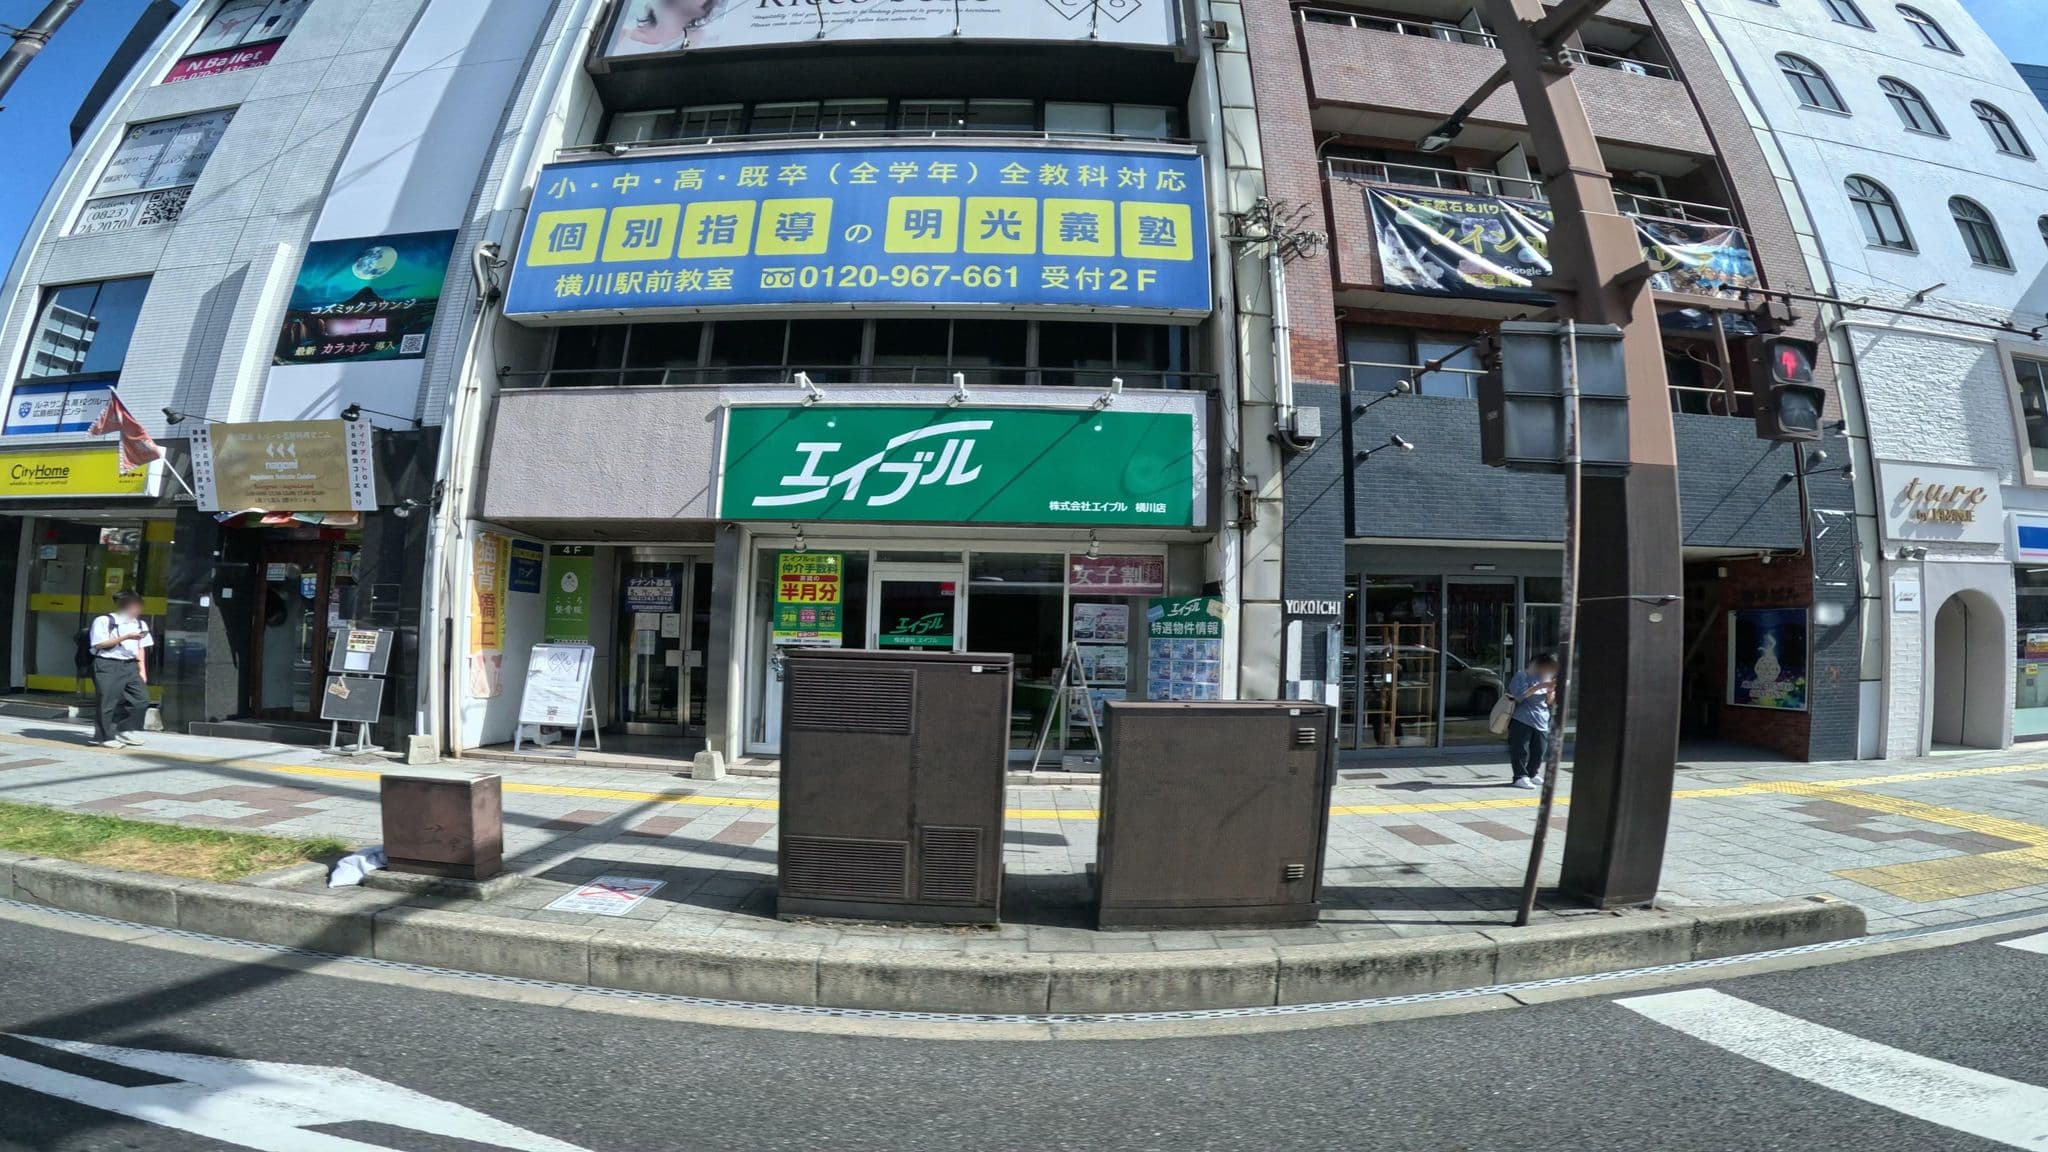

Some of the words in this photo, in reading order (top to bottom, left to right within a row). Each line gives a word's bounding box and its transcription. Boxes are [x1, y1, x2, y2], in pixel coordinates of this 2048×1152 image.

[548, 208, 1177, 253] 個別指導の明光義塾
[555, 267, 734, 298] 横川駅前教室
[799, 265, 1018, 289] 0120-967-661
[311, 298, 417, 315] コズミックラウンジ
[321, 342, 370, 355] カラオケ
[752, 420, 993, 506] エイブル
[1049, 501, 1128, 512] 株式会社エイブル
[1135, 502, 1167, 513] 横川店
[1075, 564, 1143, 586] 女子割
[780, 583, 837, 601] 半月分
[1167, 598, 1202, 617] エイブル
[1285, 600, 1341, 615] YOKOICHI
[889, 612, 945, 634] エイブル
[1151, 621, 1219, 636] 特選物件情報
